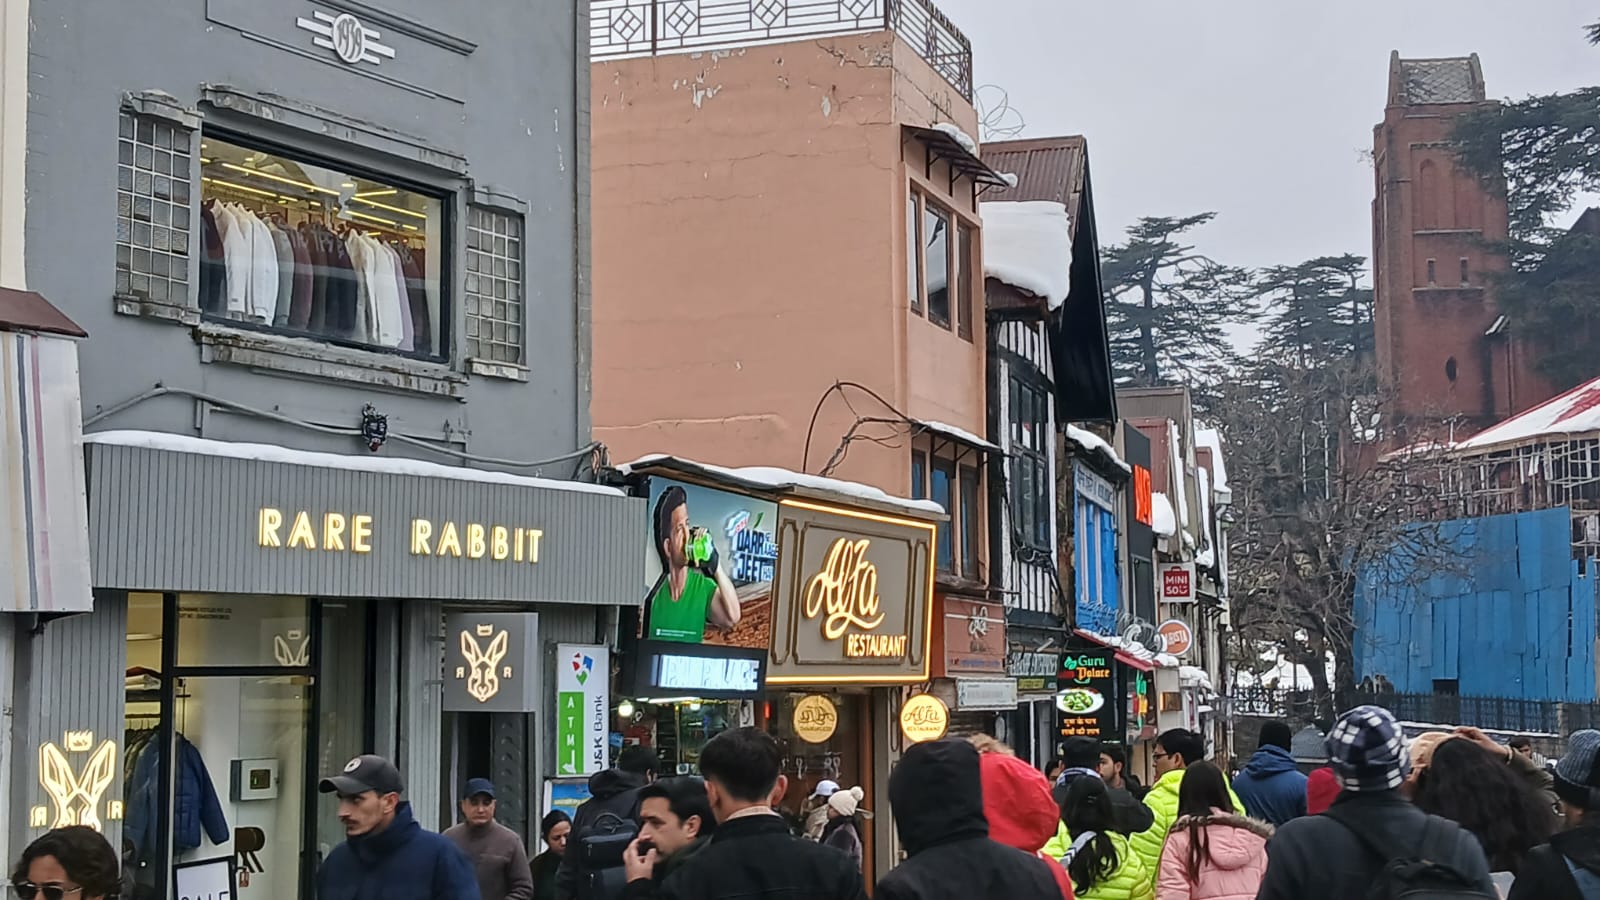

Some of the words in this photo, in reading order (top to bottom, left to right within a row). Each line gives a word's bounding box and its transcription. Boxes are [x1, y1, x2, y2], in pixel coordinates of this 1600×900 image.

[258, 507, 373, 553] RARE
[411, 518, 543, 564] RABBIT
[738, 553, 765, 583] JEET
[1165, 575, 1188, 585] MINI
[845, 634, 908, 659] RESTAURANT
[1078, 654, 1105, 667] Guru
[503, 666, 512, 679] R
[566, 695, 575, 746] ATM
[593, 694, 603, 732] Bank
[593, 736, 603, 771] J&K
